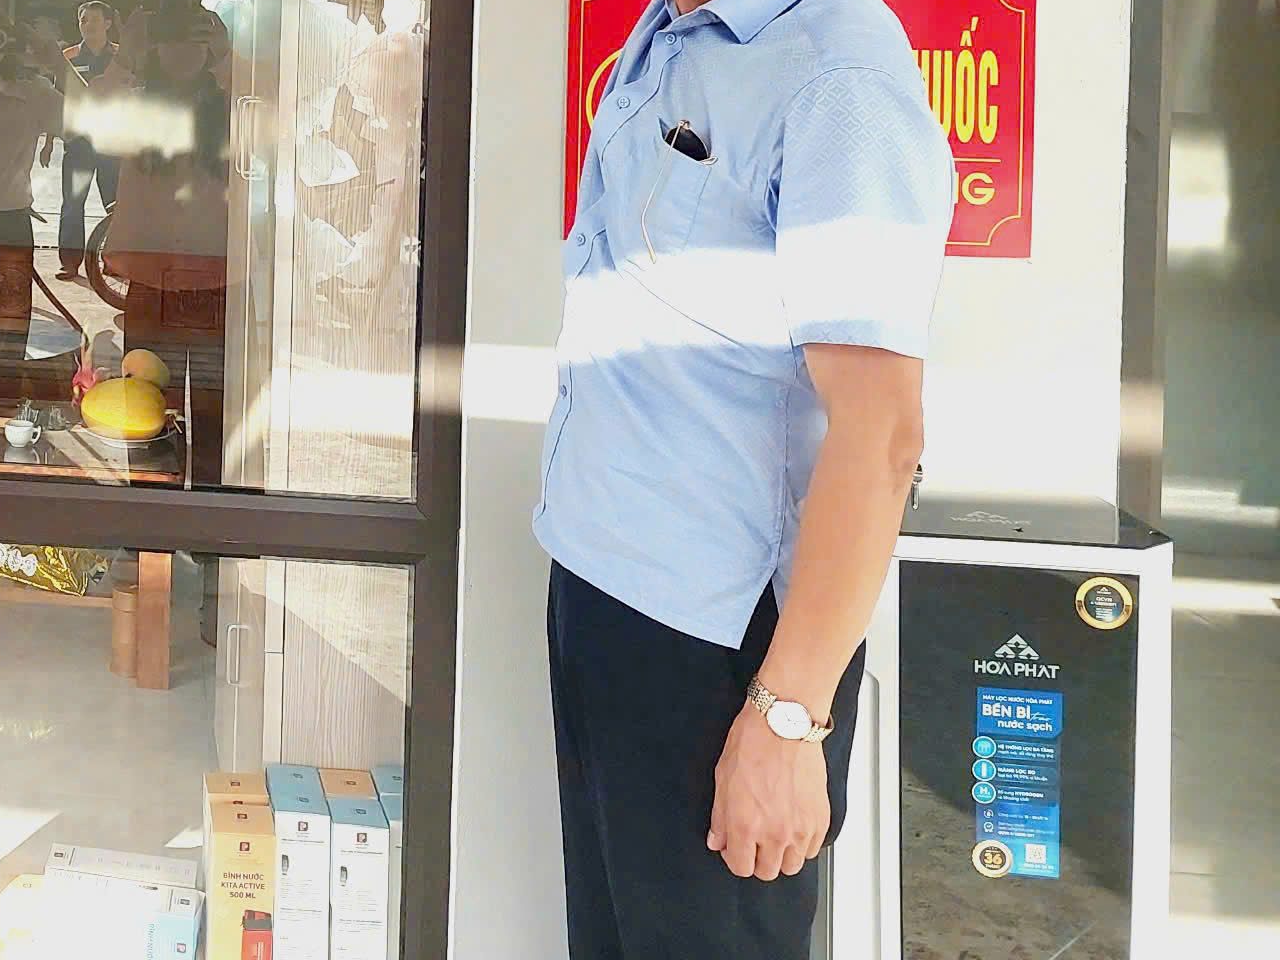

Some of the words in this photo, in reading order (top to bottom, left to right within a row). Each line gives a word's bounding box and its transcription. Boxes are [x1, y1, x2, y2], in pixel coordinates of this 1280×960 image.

[1014, 662, 1060, 678] PHÁT
[998, 720, 1024, 728] nước
[1026, 723, 1052, 732] sạch
[984, 852, 1003, 865] 36
[239, 882, 265, 890] ACTIVE
